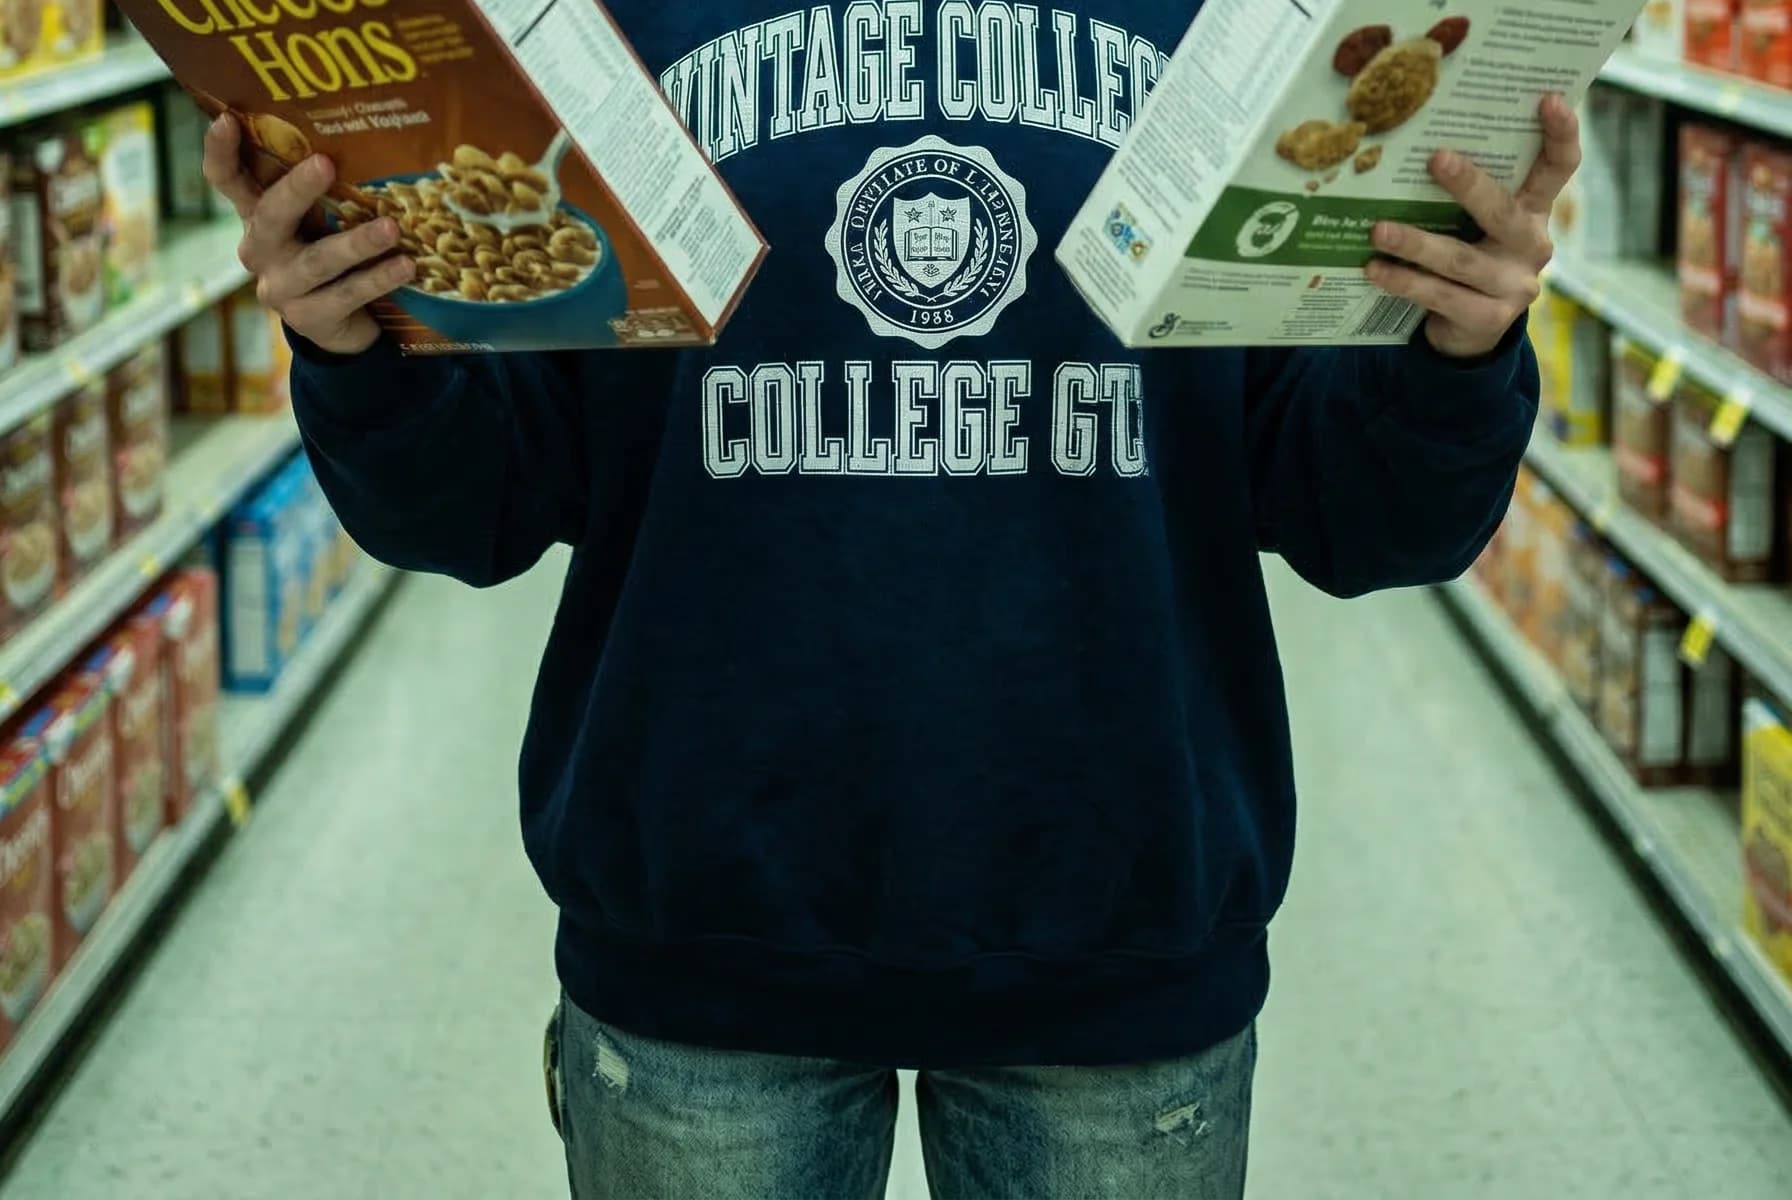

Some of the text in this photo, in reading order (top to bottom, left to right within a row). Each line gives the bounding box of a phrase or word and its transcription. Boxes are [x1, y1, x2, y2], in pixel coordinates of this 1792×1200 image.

[230, 20, 418, 102] Hons
[934, 159, 961, 175] OF
[910, 309, 954, 325] 1988
[702, 359, 1032, 478] COLLEGE
